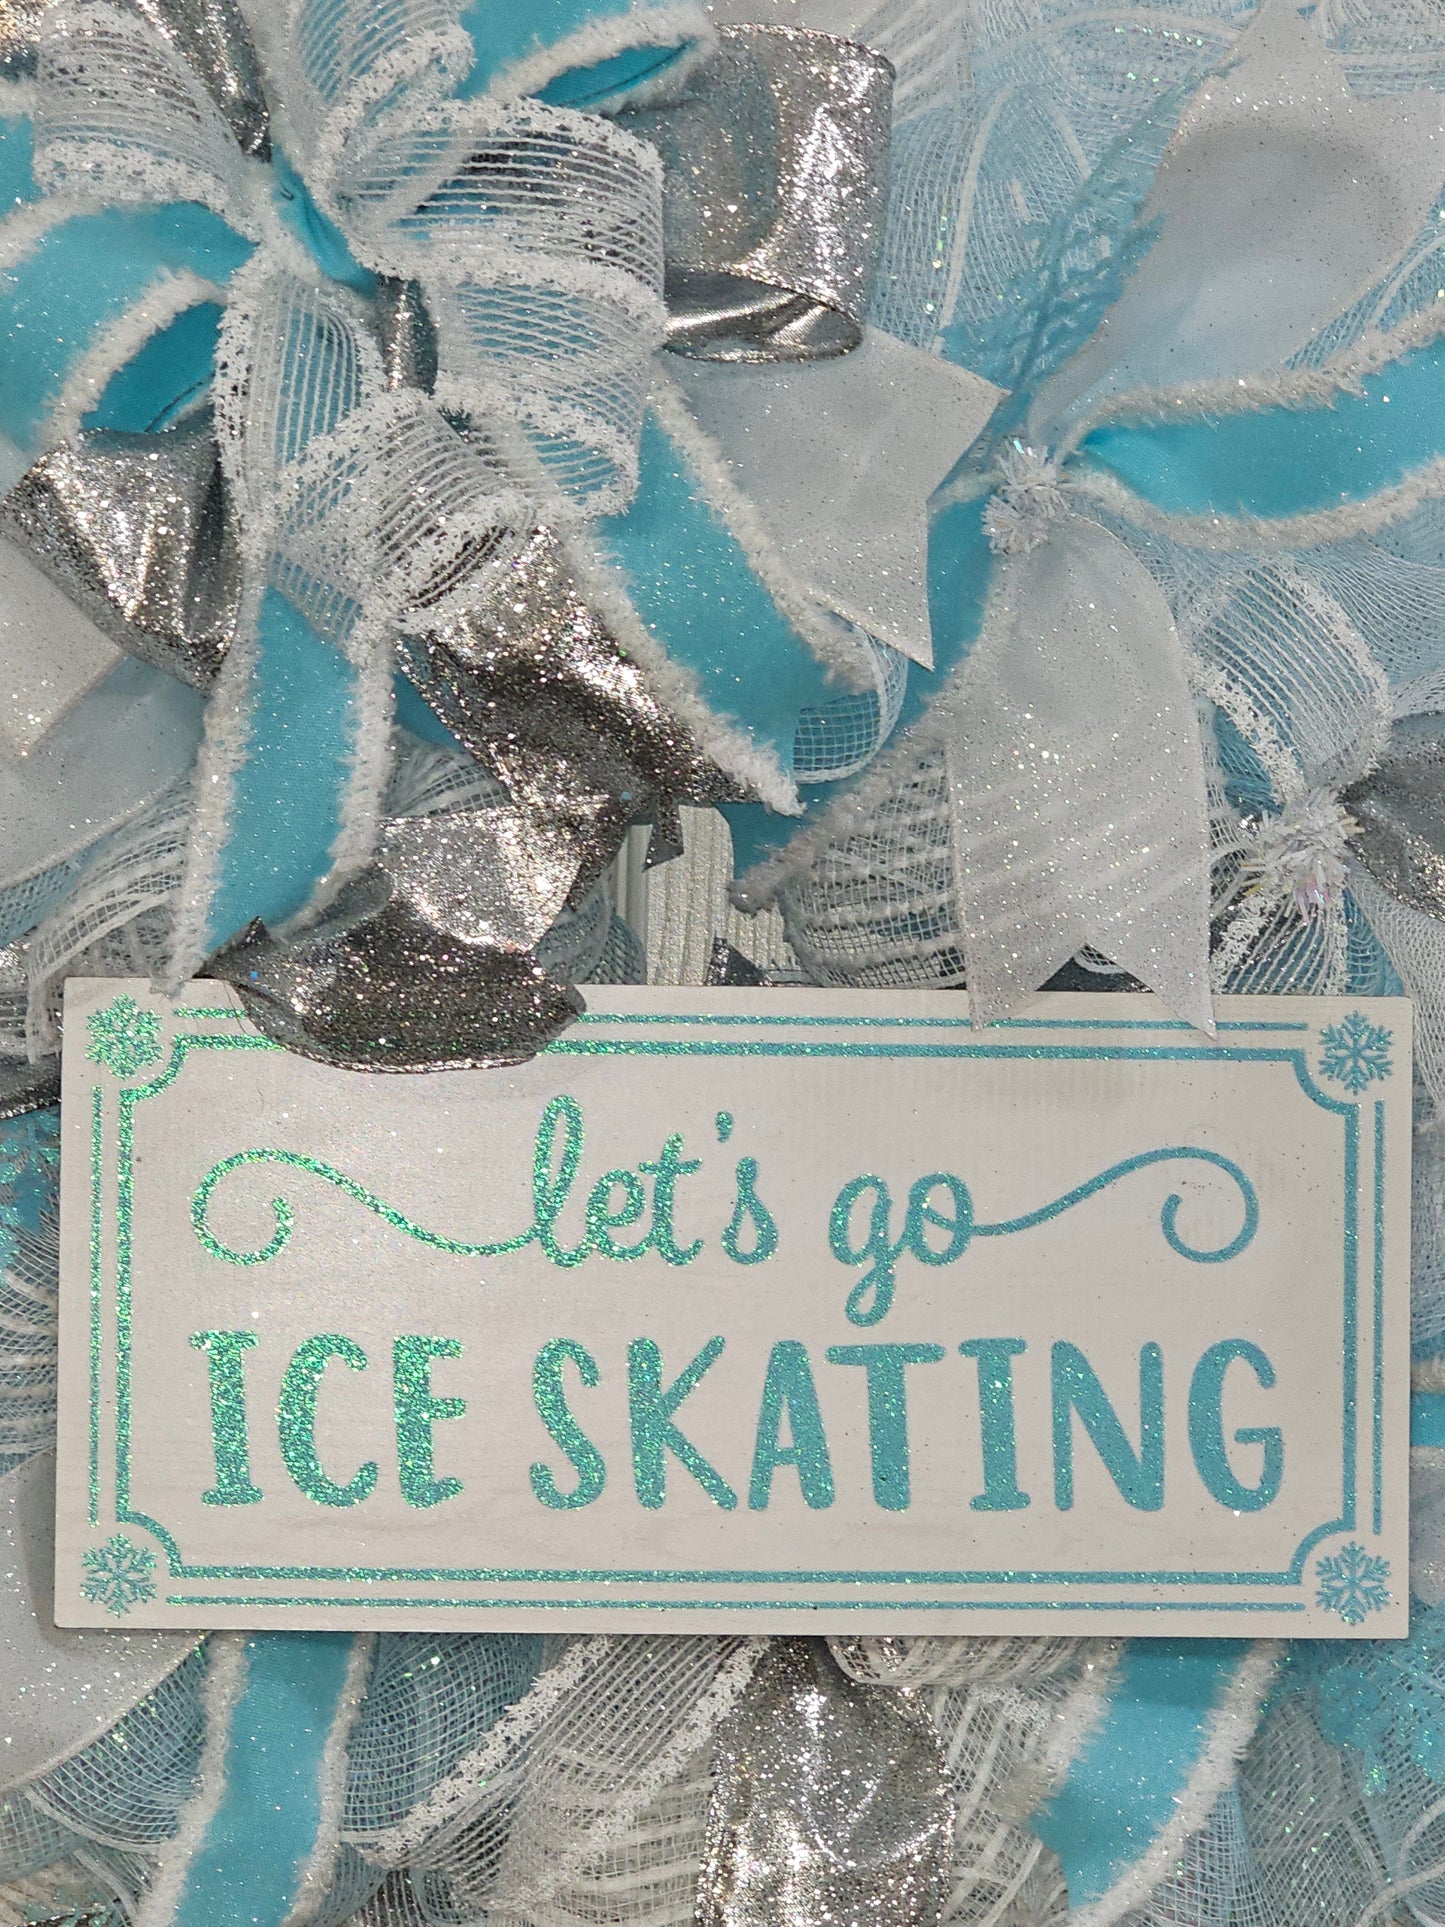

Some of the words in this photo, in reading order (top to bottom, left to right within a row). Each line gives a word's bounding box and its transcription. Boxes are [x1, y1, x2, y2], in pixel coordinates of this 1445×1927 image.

[532, 1095, 779, 1268] let's
[828, 1172, 975, 1327] go
[190, 1331, 468, 1509] ICE
[530, 1337, 1285, 1513] SKATING
